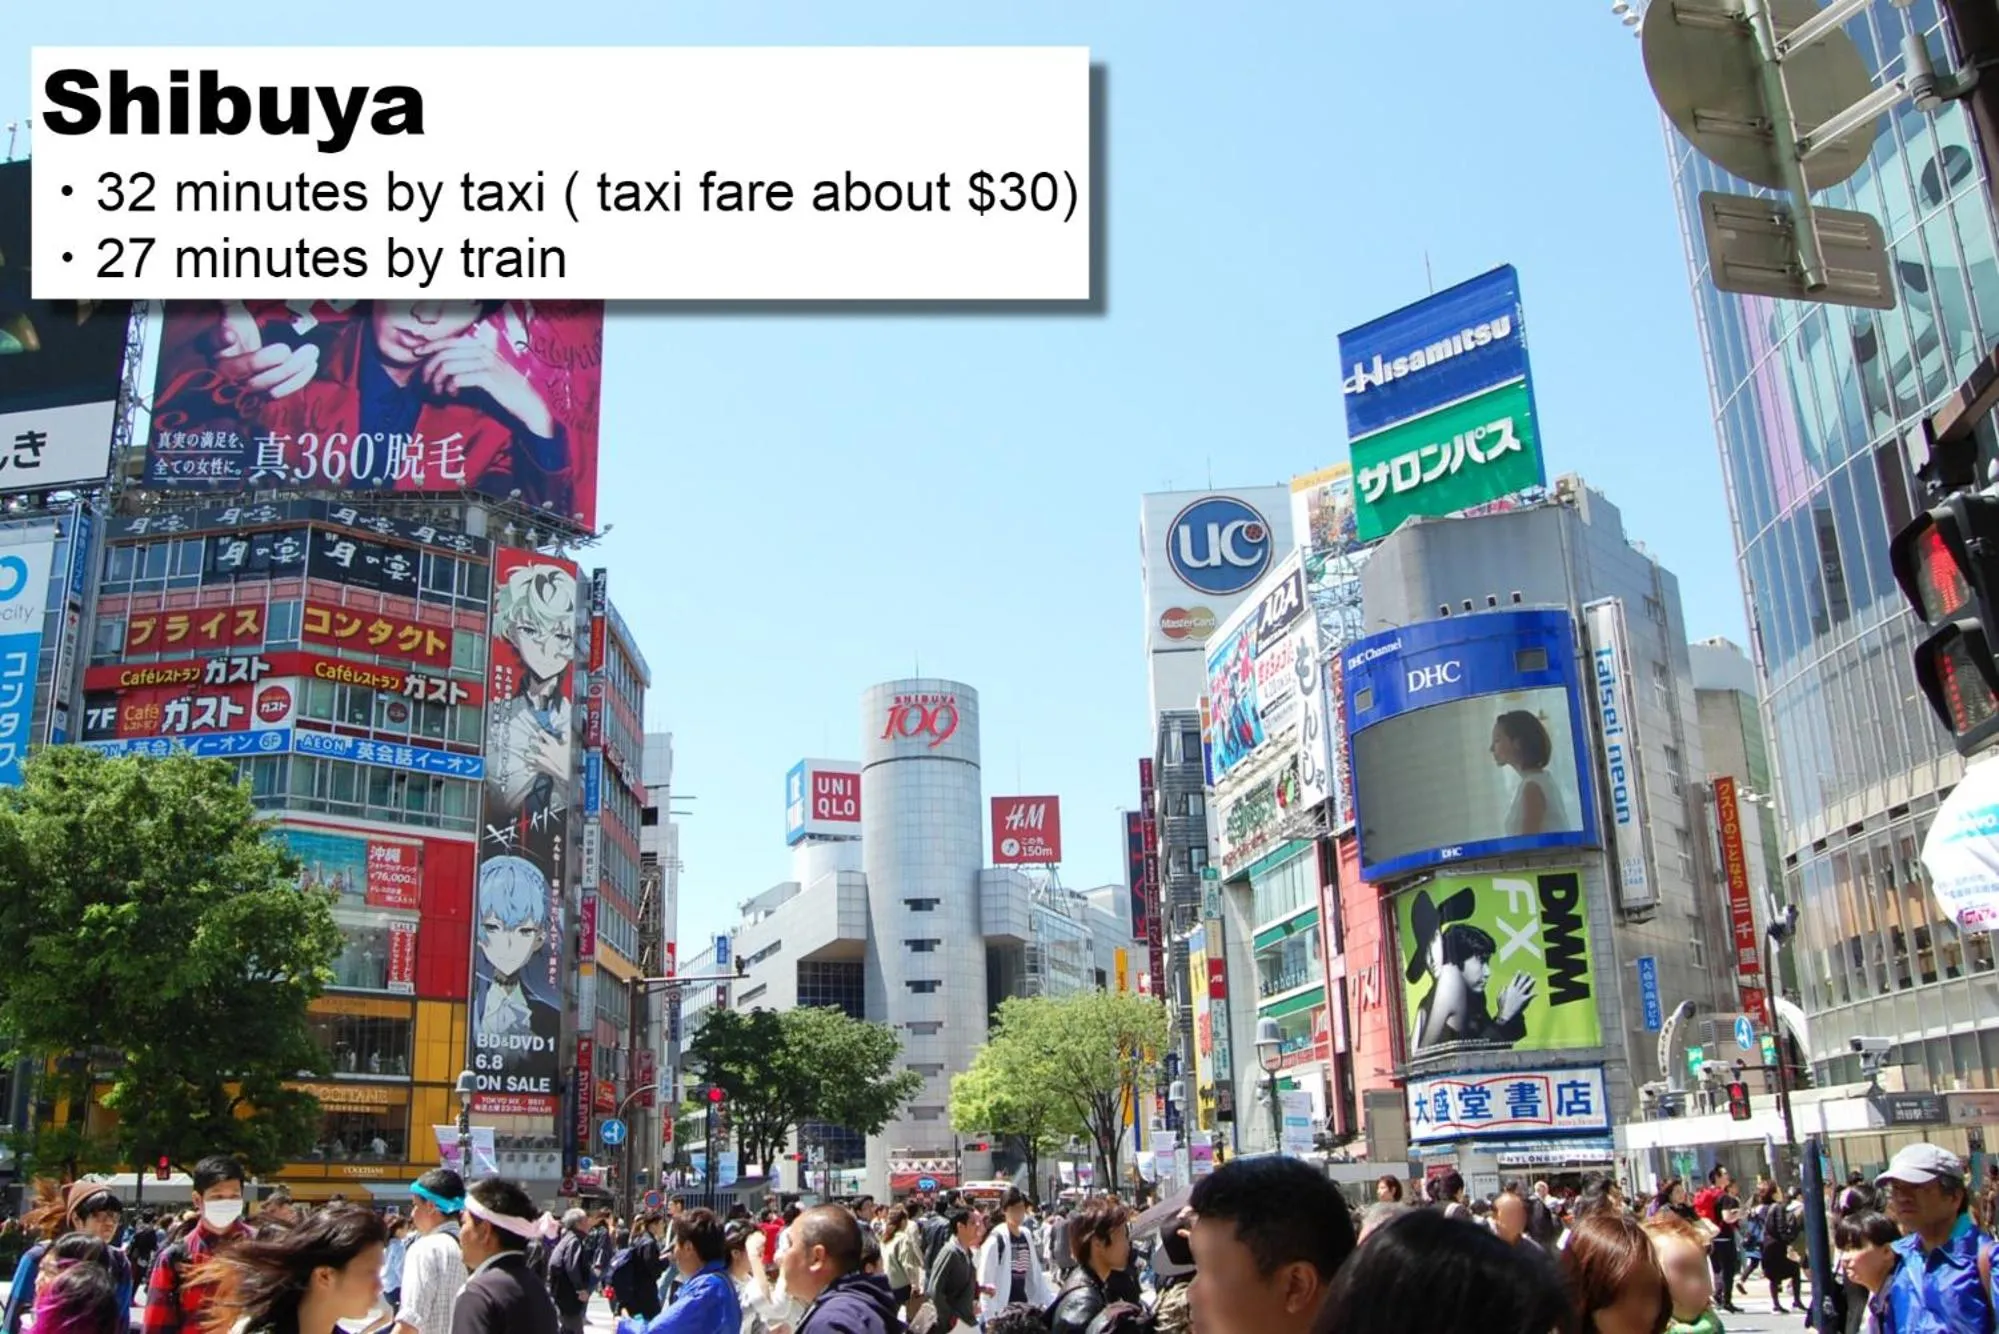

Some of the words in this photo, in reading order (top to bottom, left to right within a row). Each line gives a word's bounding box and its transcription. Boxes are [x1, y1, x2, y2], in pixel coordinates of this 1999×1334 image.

[1342, 315, 1511, 394] Hisamitsu
[1357, 416, 1522, 504] サロンパス
[0, 603, 35, 625] city
[131, 608, 261, 646] プライス
[304, 606, 447, 656] コンタクト
[1366, 637, 1402, 662] Channel
[203, 655, 270, 685] ガスト
[1407, 661, 1461, 693] DHC
[403, 673, 468, 705] ガスト
[894, 694, 957, 705] SHIBUYA
[86, 707, 117, 729] 7F
[161, 695, 244, 733] ガスト
[881, 703, 959, 749] 109
[303, 734, 347, 752] AEON
[358, 741, 481, 775] 英会話イーオン
[817, 777, 852, 795] UNI
[1607, 744, 1630, 824] neon
[818, 797, 856, 818] QLO
[1005, 803, 1046, 831] H&M
[1022, 846, 1053, 857] 150m
[1441, 846, 1464, 859] DHC
[1492, 877, 1542, 960] FX
[1537, 872, 1591, 1006] DMM
[548, 1036, 555, 1052] 1
[475, 1054, 503, 1070] 6.8
[477, 1075, 501, 1091] ON
[507, 1076, 551, 1093] SALE
[1415, 1080, 1593, 1125] 大盛堂書店
